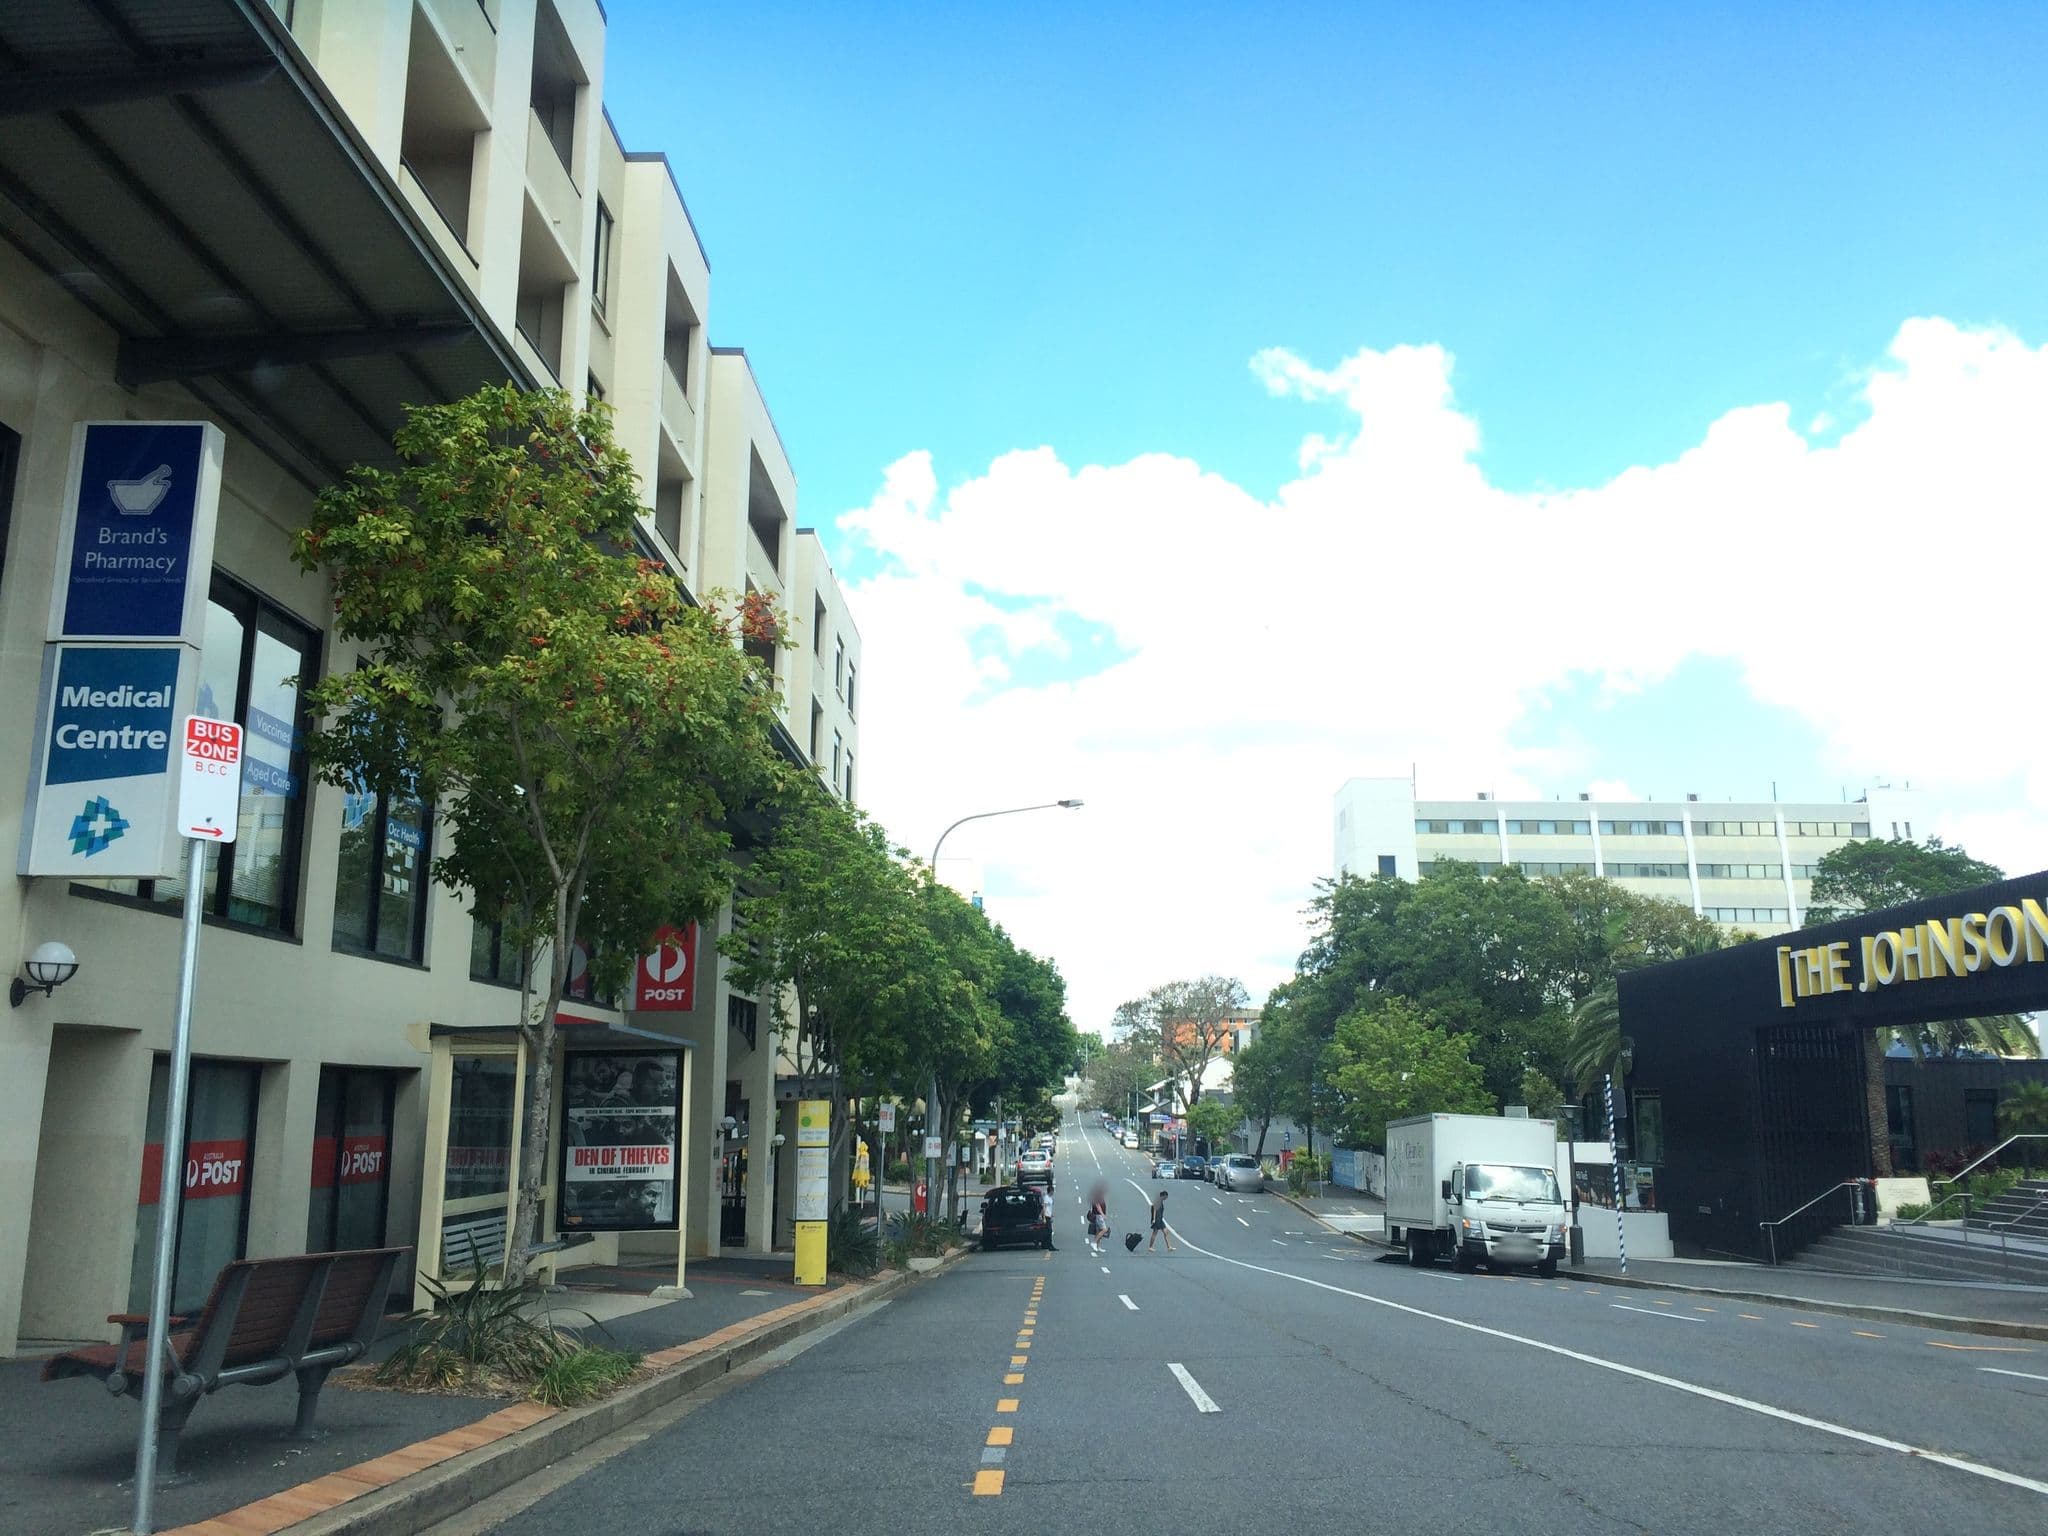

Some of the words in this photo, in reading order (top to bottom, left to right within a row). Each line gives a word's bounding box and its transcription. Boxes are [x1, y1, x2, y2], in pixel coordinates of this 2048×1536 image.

[98, 527, 168, 544] Brand's
[84, 551, 177, 574] Pharmacy
[61, 684, 172, 708] Medical
[55, 723, 168, 751] Centre
[193, 720, 233, 743] BUS
[256, 714, 291, 744] Vaccines
[186, 738, 239, 763] ZONE
[246, 761, 270, 782] Aged
[271, 771, 292, 791] Care
[388, 822, 401, 839] Occ
[401, 827, 420, 845] Health
[1858, 898, 2048, 993] JOHNSON
[644, 988, 686, 1001] POST
[351, 1151, 383, 1175] POST
[575, 1147, 599, 1166] DEN
[601, 1147, 617, 1166] OF
[620, 1147, 670, 1165] THIEVES
[200, 1159, 242, 1186] POST
